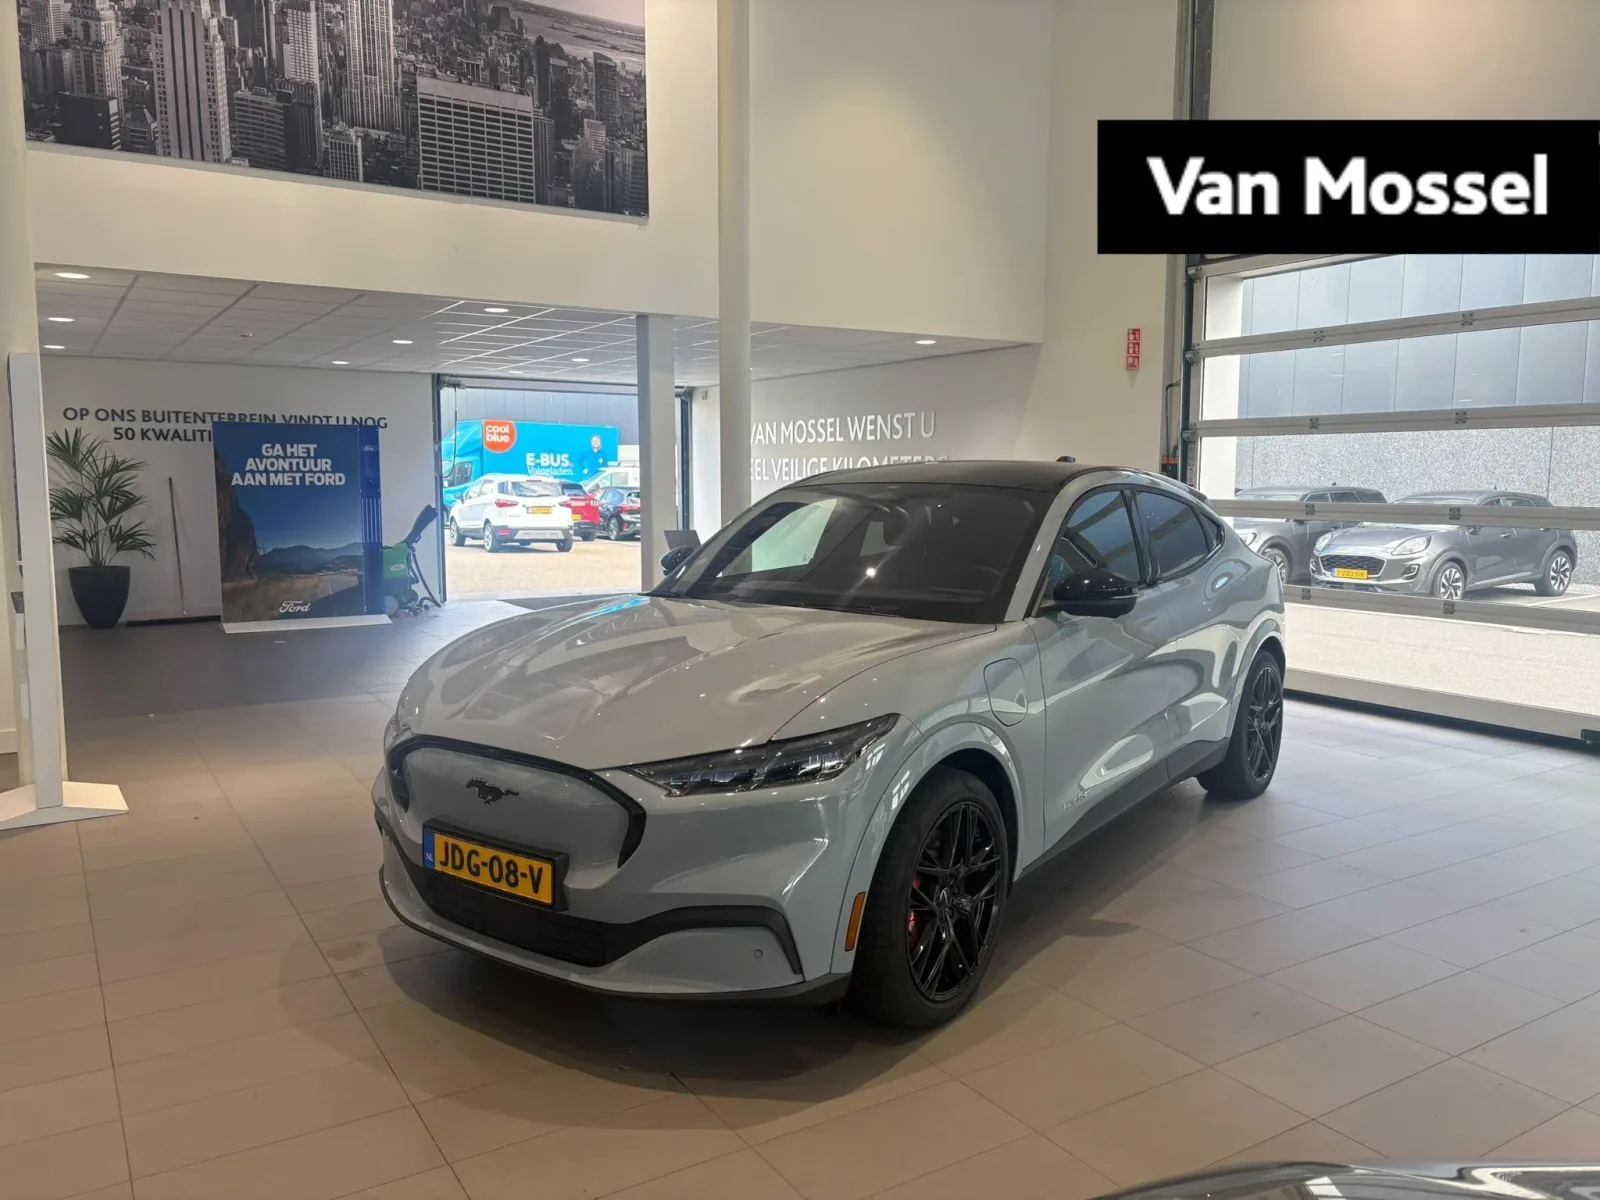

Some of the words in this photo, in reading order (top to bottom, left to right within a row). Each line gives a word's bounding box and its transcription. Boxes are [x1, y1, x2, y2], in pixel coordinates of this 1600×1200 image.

[63, 407, 90, 421] OP
[95, 408, 136, 422] ONS
[113, 427, 136, 441] 50
[141, 428, 213, 442] KWALIT
[486, 424, 510, 434] cool
[780, 417, 844, 444] MOSSEL
[847, 412, 916, 441] WENST
[920, 411, 935, 438] U
[486, 432, 510, 443] blue
[261, 443, 284, 457] GA
[286, 443, 318, 457] HET
[245, 457, 332, 472] AVONTUUR
[231, 472, 267, 486] AAN
[269, 472, 302, 486] MET
[305, 472, 346, 486] FORD
[279, 600, 311, 613] Ford
[425, 852, 434, 862] NL
[440, 841, 543, 894] JDG-08-V
